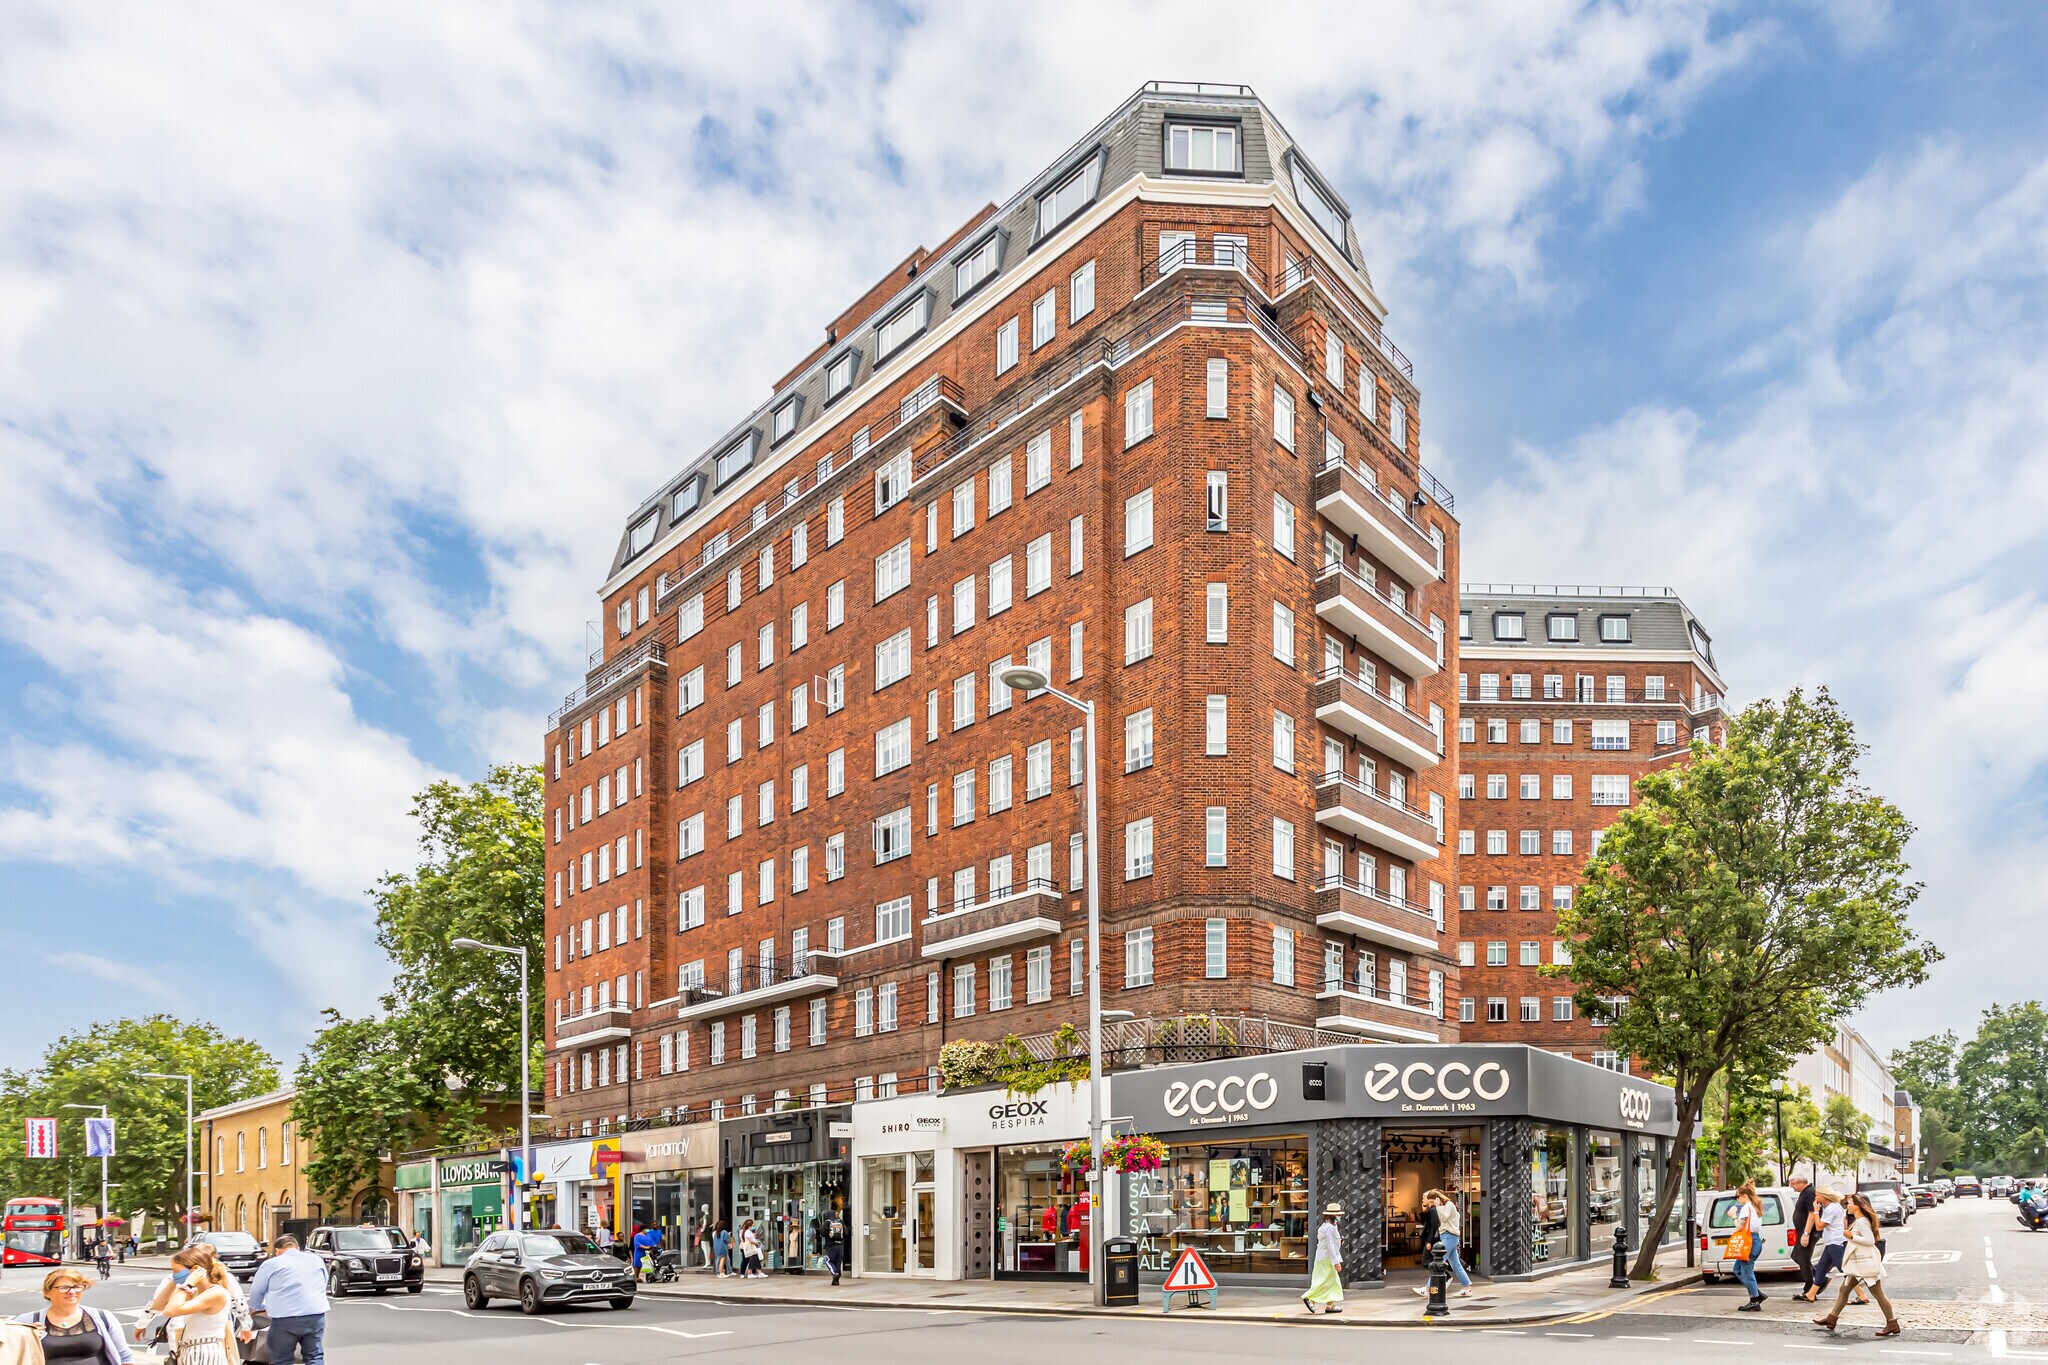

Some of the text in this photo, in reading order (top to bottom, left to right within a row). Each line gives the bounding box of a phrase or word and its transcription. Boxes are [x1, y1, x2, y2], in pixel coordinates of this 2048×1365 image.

[1309, 1079, 1323, 1087] ecco
[1364, 1062, 1510, 1102] ecco
[1163, 1072, 1278, 1117] ecco
[988, 1100, 1048, 1120] GEOX
[1401, 1104, 1414, 1112] Est.
[1416, 1103, 1449, 1112] Denmark
[1457, 1103, 1476, 1111] 1963
[1620, 1087, 1651, 1122] ecco
[991, 1116, 1045, 1130] RESPIRA
[1201, 1115, 1227, 1124] Denmark
[1233, 1113, 1249, 1122] 1963
[882, 1122, 910, 1134] SHIRO
[441, 1162, 500, 1184] LLOYDS BA
[1130, 1182, 1151, 1199] SA
[1130, 1201, 1139, 1216] S
[1130, 1218, 1151, 1234] SA
[1137, 1254, 1171, 1270] ALE
